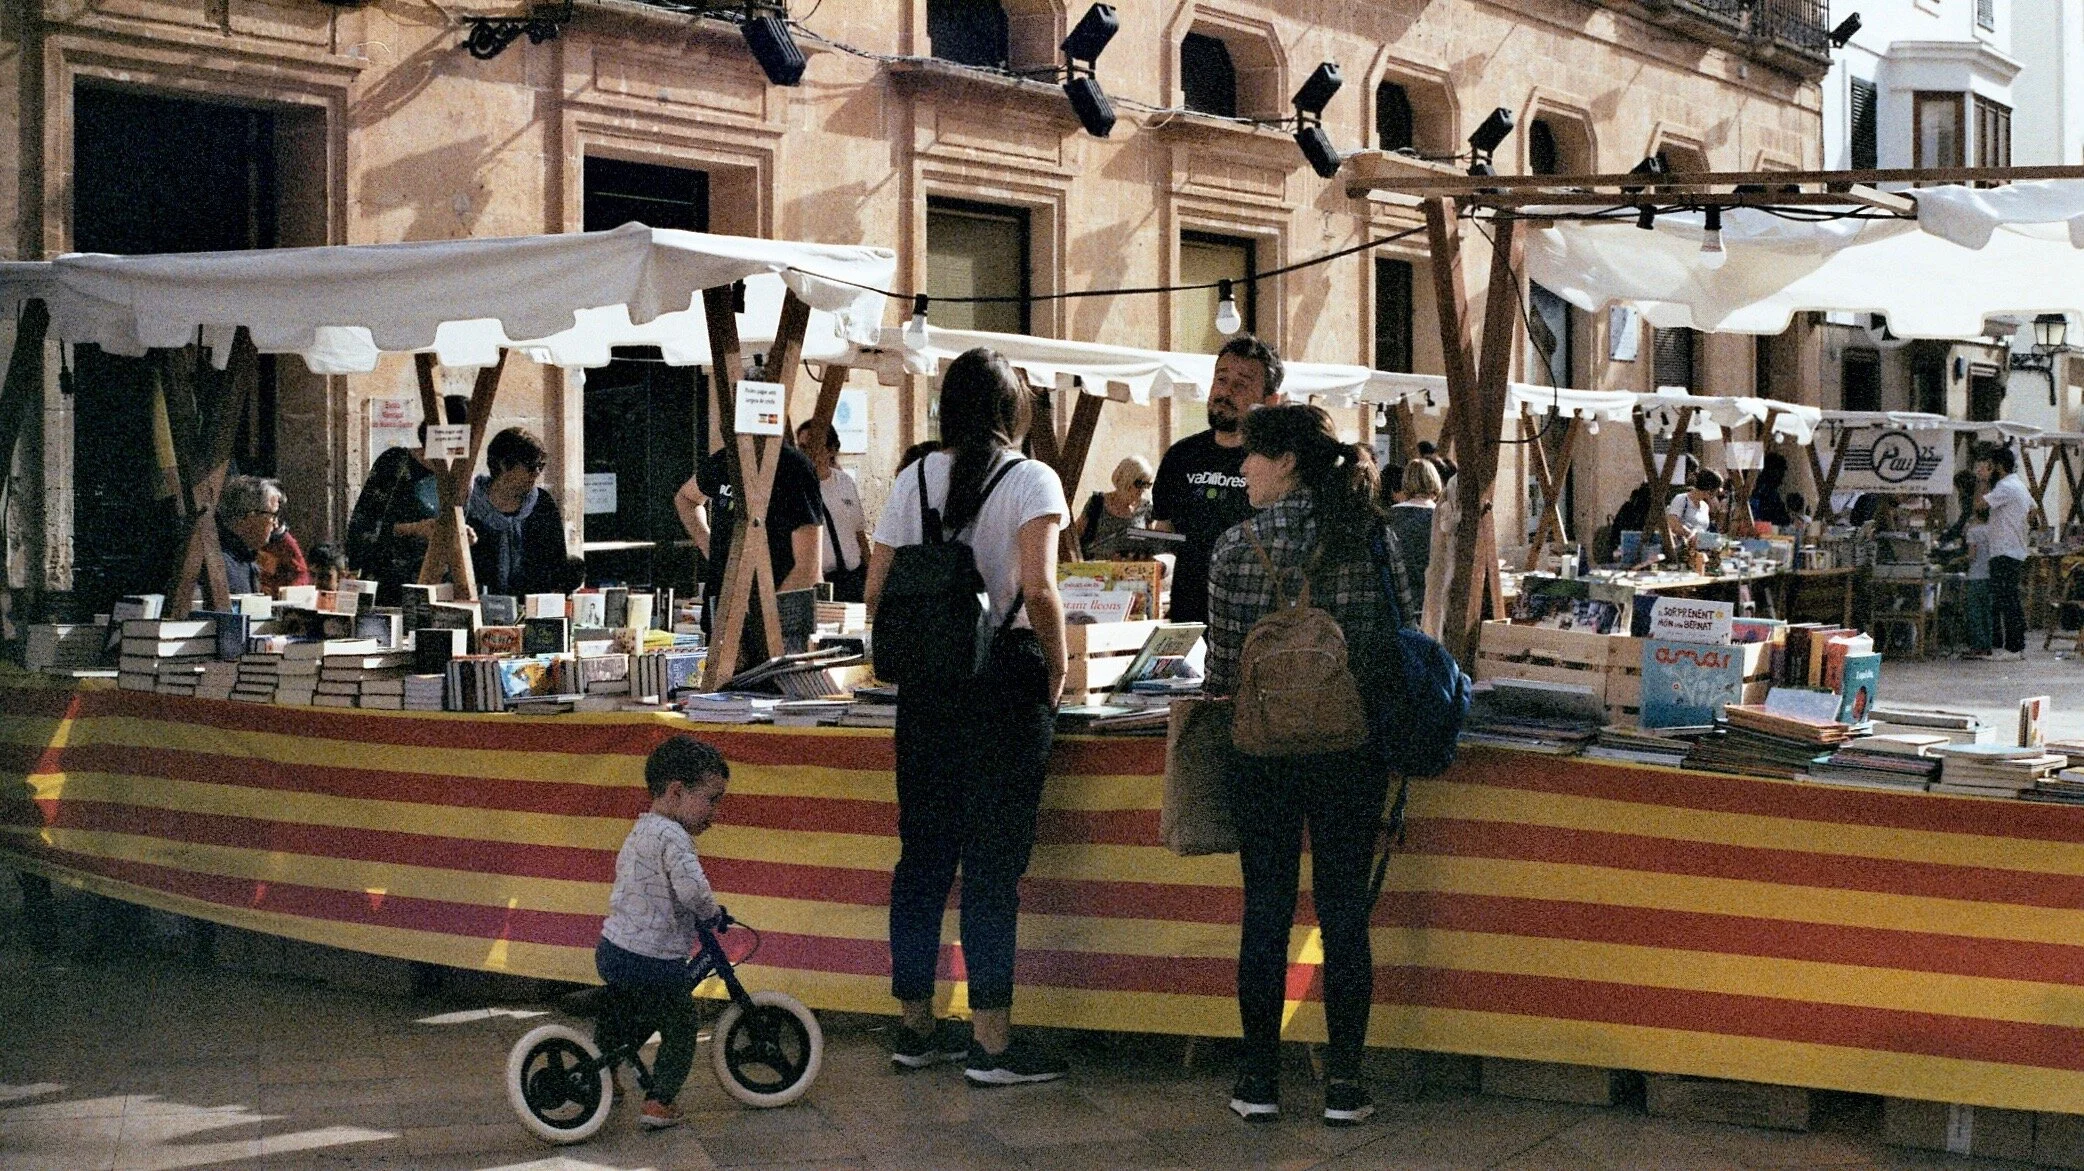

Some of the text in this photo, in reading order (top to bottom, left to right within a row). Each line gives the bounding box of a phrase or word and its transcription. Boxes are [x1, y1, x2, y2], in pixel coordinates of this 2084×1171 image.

[1090, 599, 1121, 611] lleons
[1663, 607, 1715, 620] SORPRENENT
[1683, 620, 1713, 631] BERNAT
[1655, 647, 1732, 669] amar
